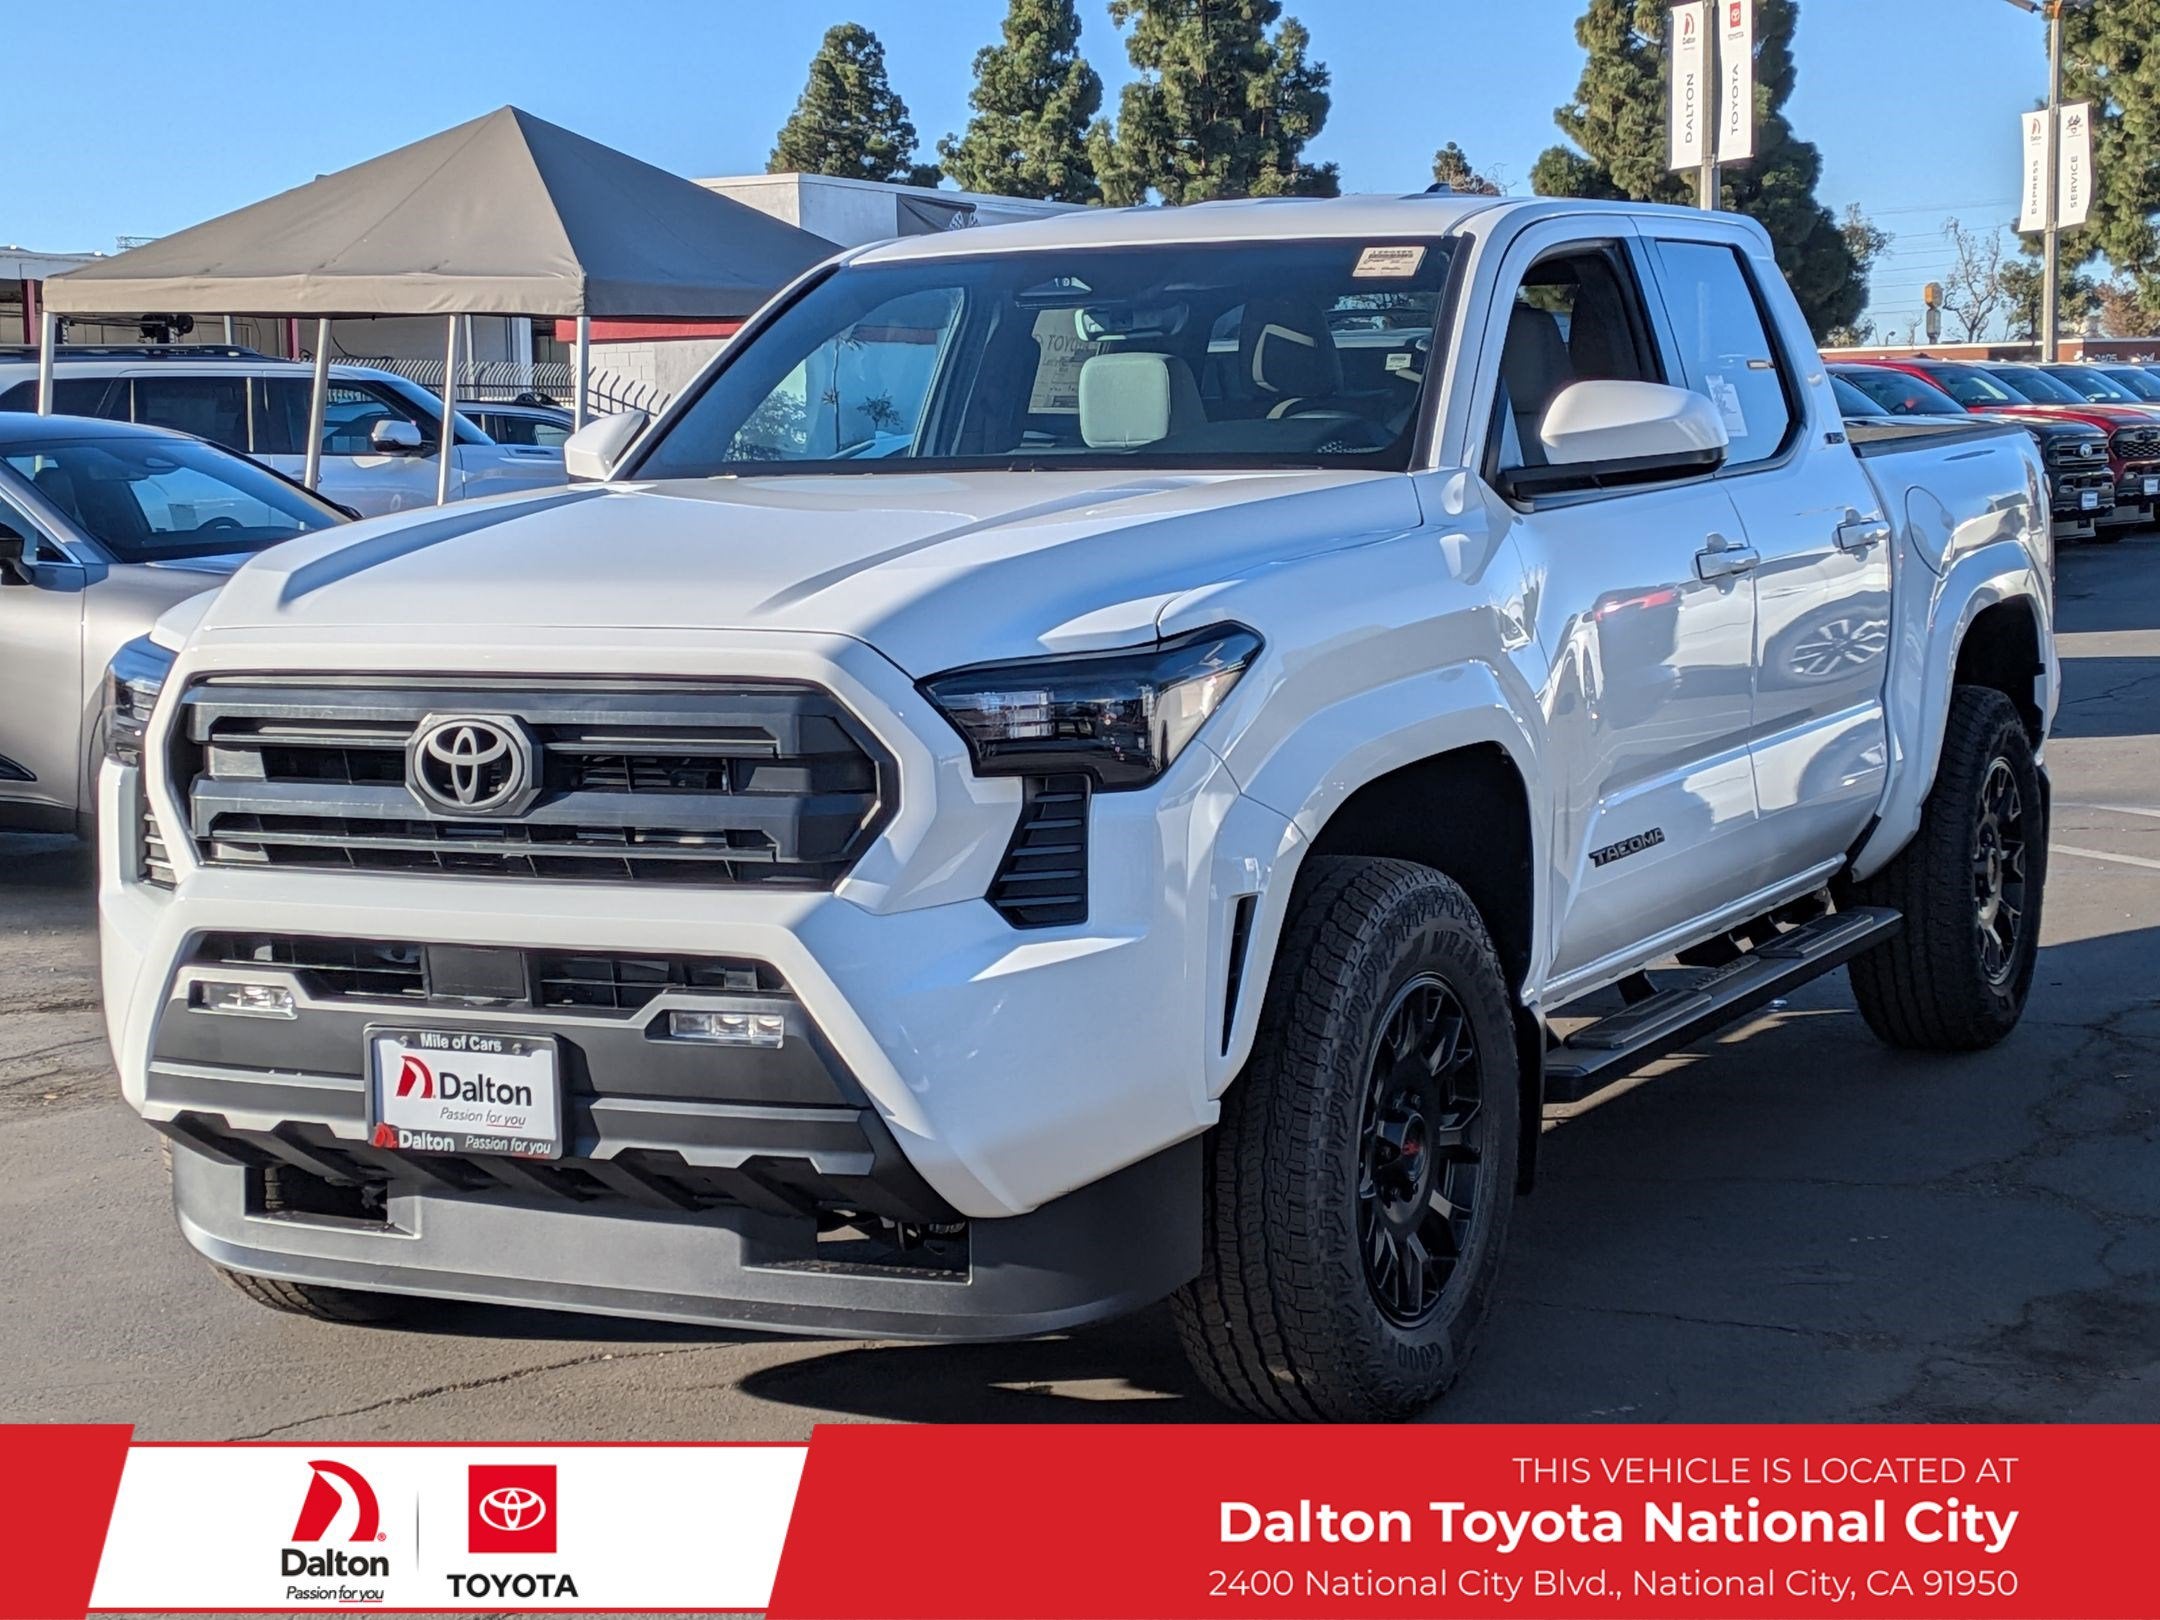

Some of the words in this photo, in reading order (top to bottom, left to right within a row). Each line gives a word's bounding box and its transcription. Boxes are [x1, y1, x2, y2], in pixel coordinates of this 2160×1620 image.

[1685, 73, 1694, 144] DALTON
[1731, 64, 1739, 136] TOYOTA
[2031, 160, 2039, 215] EXPRESS
[2070, 155, 2078, 208] SERVICE
[420, 1032, 449, 1049] Mile
[452, 1034, 467, 1050] of
[469, 1036, 502, 1052] Cars
[439, 1072, 532, 1106] Dalton
[440, 1106, 483, 1122] Passion
[486, 1109, 502, 1123] for
[504, 1114, 526, 1127] you
[399, 1130, 455, 1152] Dalton
[465, 1135, 508, 1151] Passion
[511, 1138, 527, 1152] for
[528, 1142, 550, 1155] you
